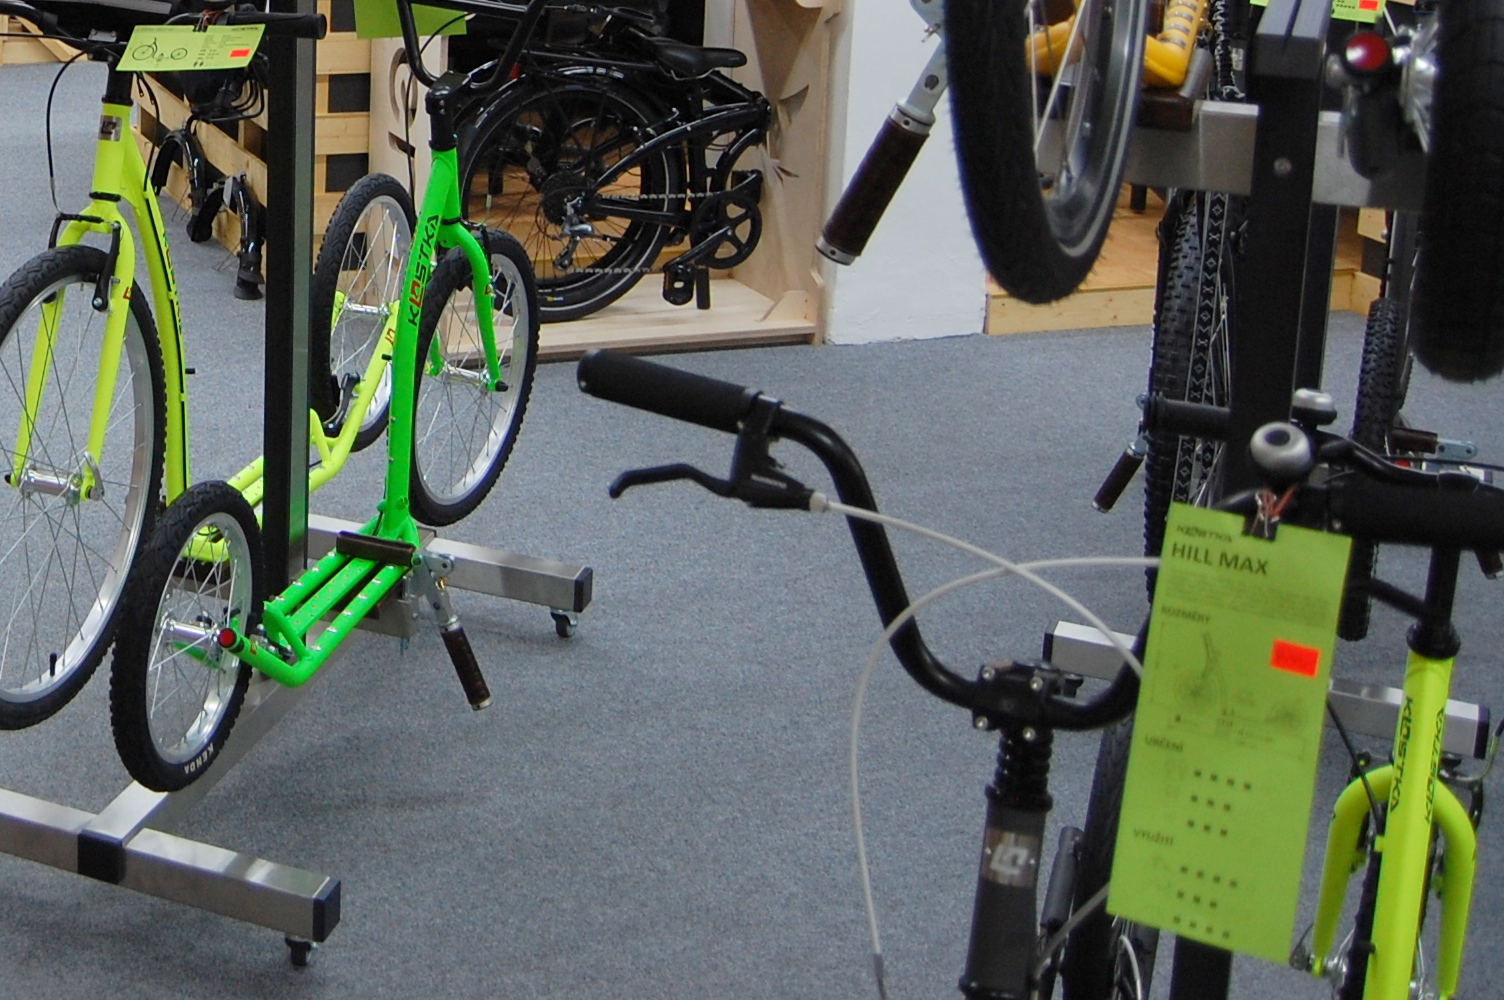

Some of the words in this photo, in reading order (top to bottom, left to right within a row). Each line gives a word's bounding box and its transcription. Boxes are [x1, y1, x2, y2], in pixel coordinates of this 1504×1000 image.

[407, 214, 439, 327] KOSTKA
[1171, 542, 1213, 567] HILL
[1219, 553, 1270, 576] MAX
[184, 742, 215, 775] KENDA
